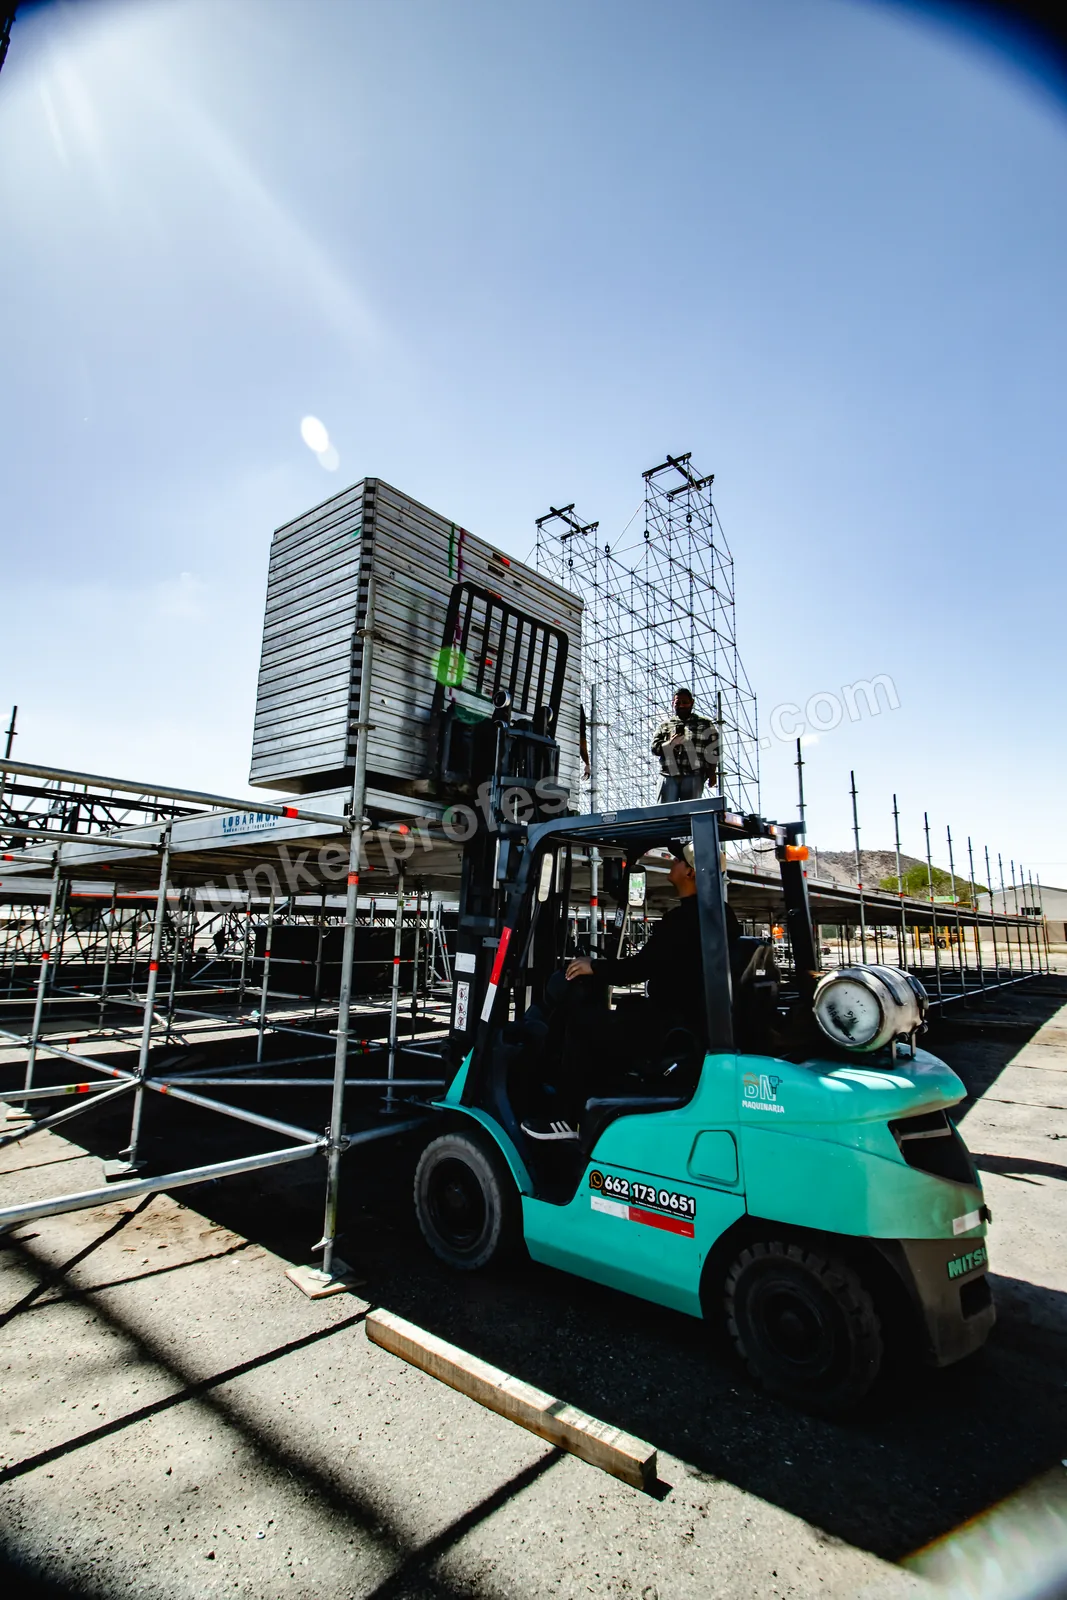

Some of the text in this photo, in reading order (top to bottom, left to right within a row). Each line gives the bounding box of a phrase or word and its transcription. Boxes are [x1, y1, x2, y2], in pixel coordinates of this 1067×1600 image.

[742, 1100, 785, 1113] MAQUINARIA
[604, 1176, 629, 1195] 662
[632, 1184, 656, 1203] 173
[659, 1191, 695, 1214] 0651
